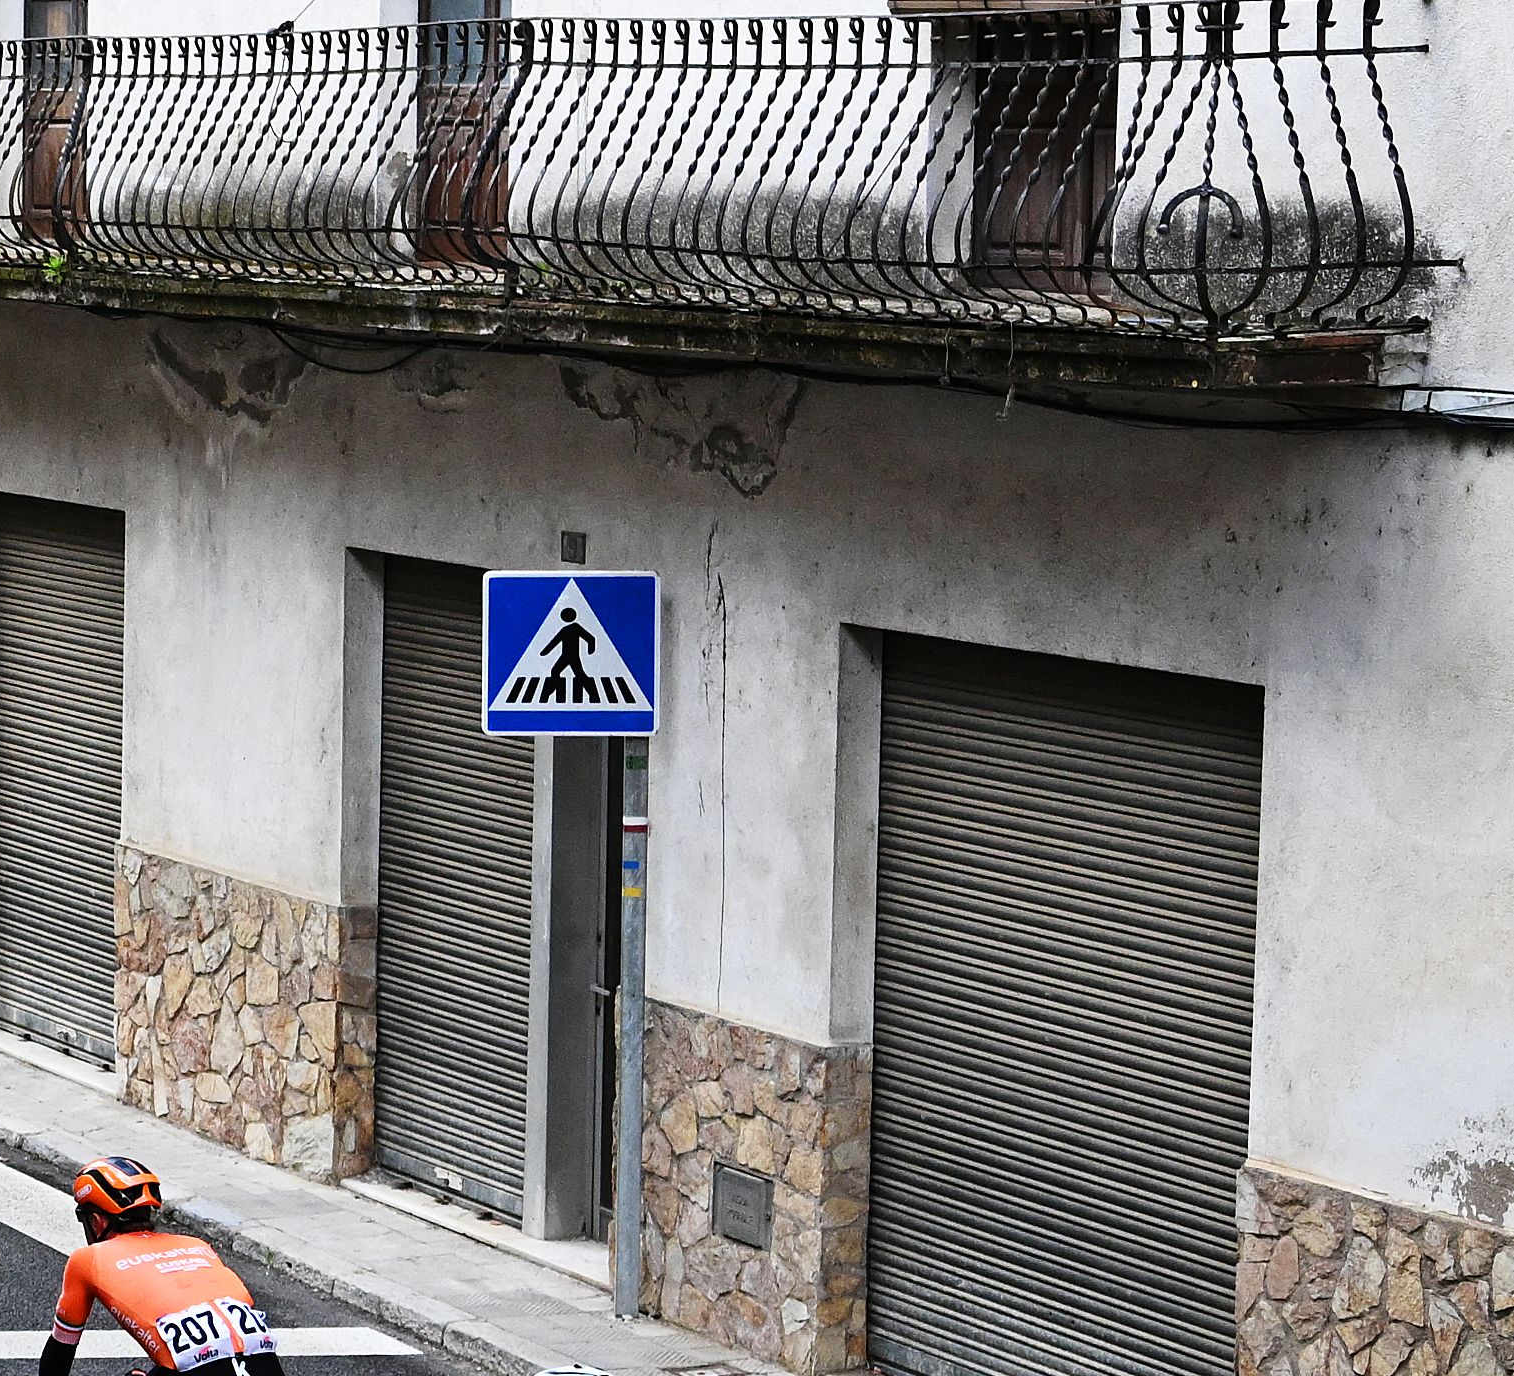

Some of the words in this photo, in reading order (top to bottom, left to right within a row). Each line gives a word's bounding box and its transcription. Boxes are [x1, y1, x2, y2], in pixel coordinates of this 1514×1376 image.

[109, 1305, 161, 1354] euskaltel
[164, 1310, 221, 1354] 207
[193, 1348, 219, 1363] Volta
